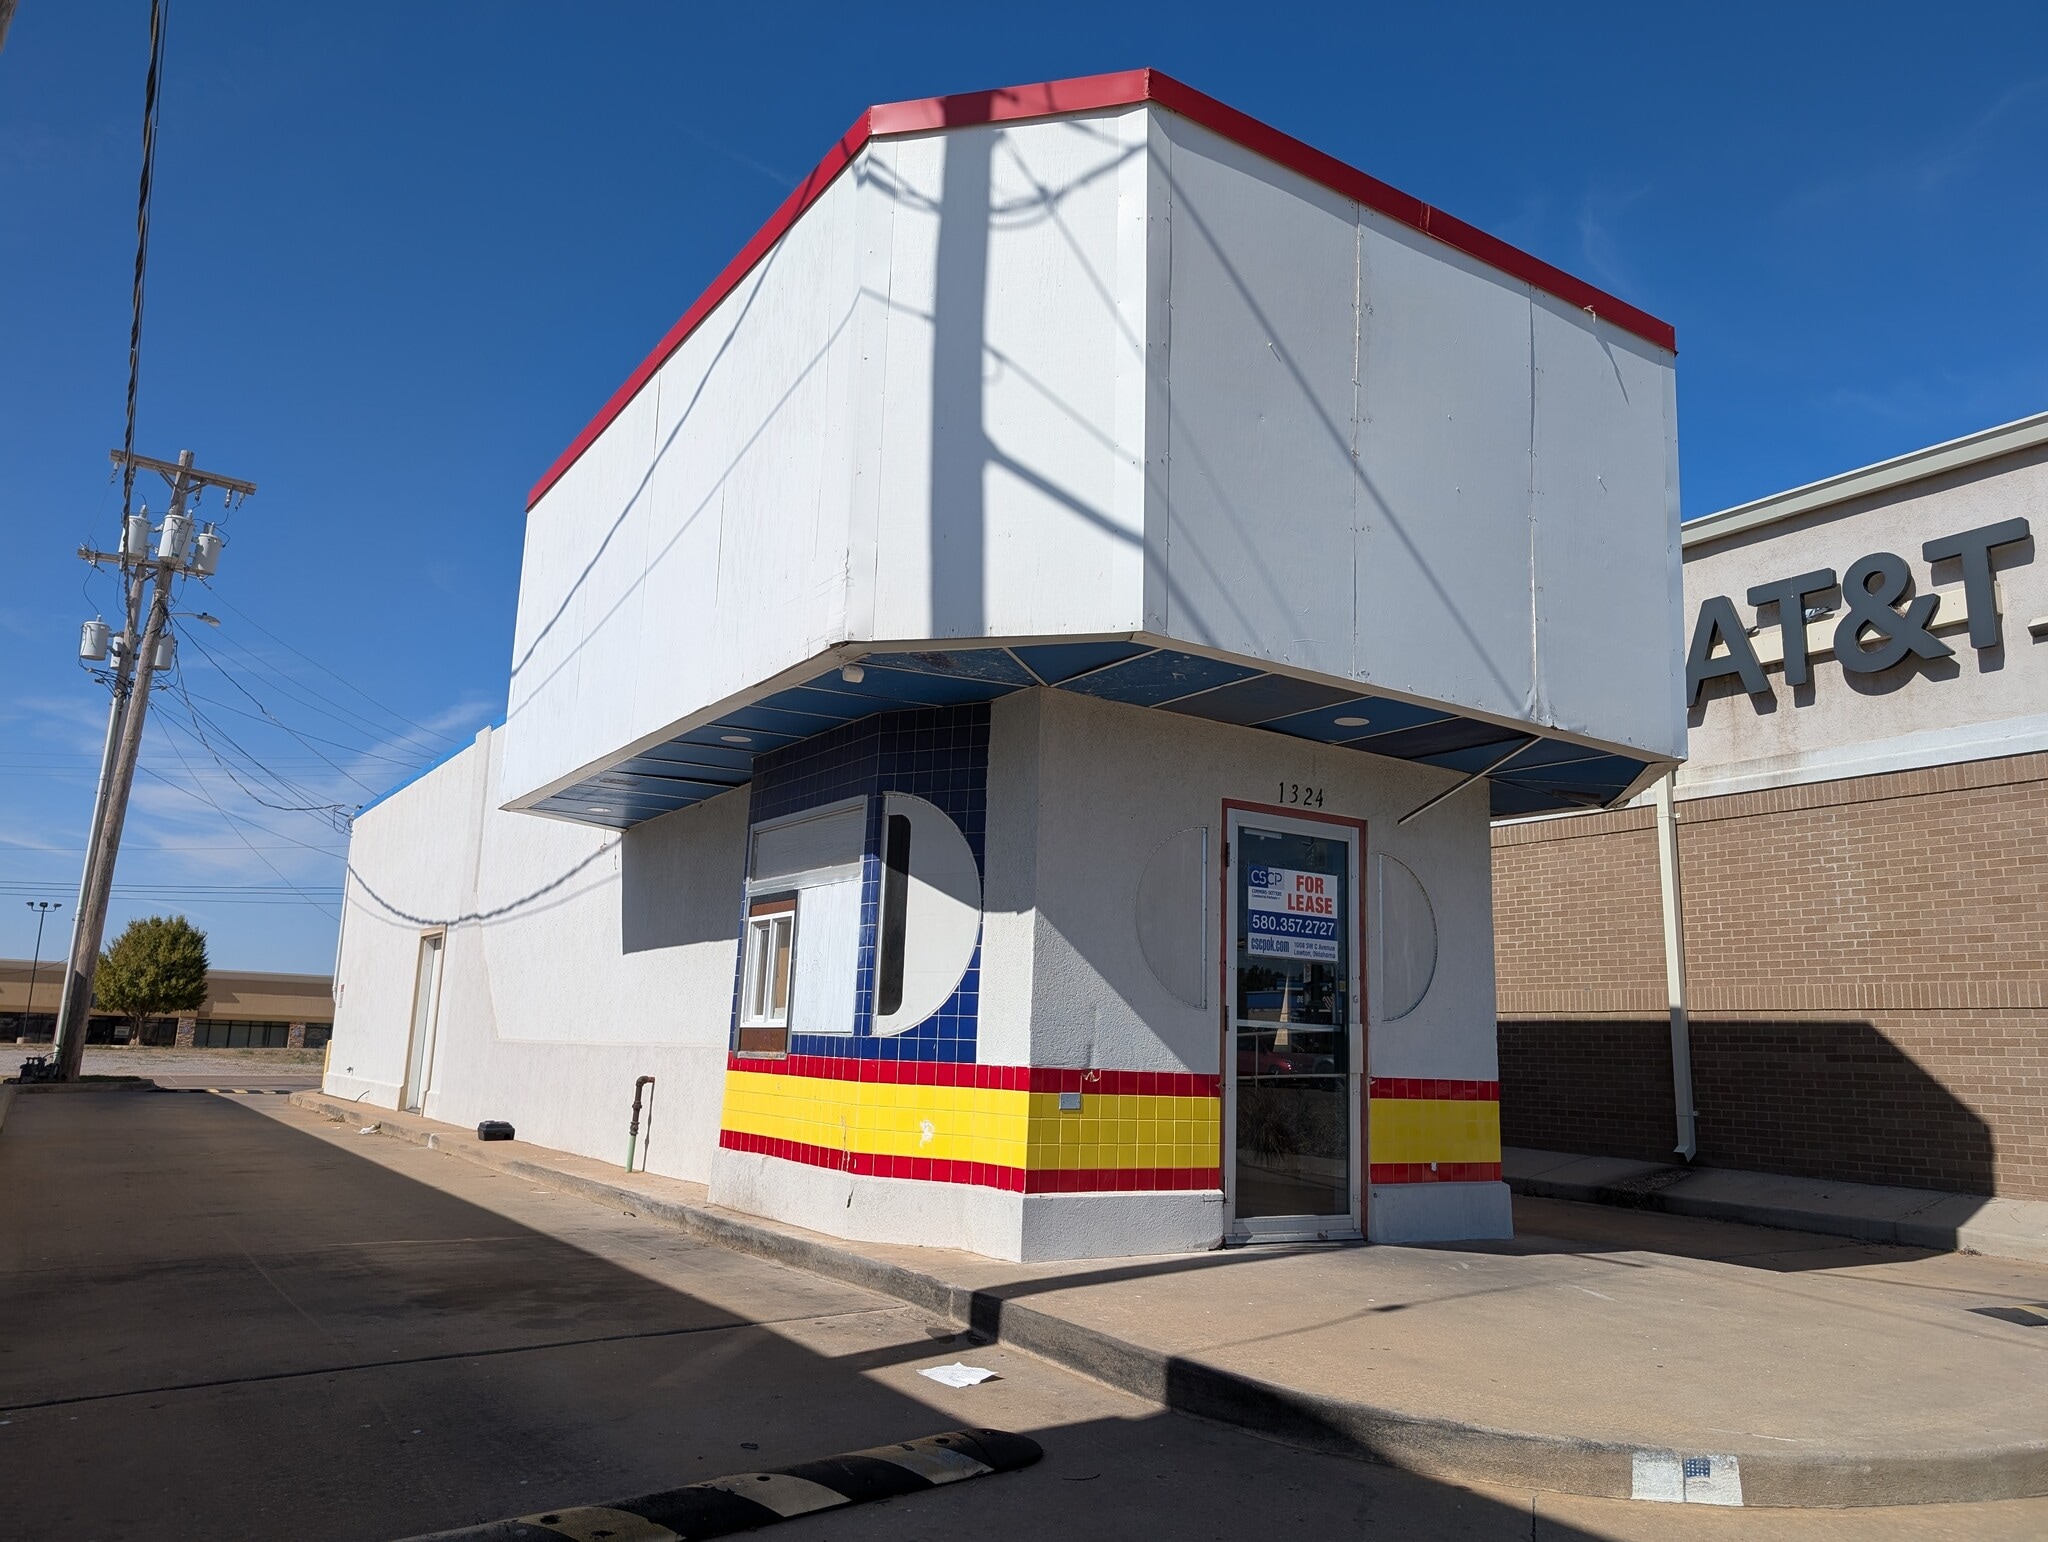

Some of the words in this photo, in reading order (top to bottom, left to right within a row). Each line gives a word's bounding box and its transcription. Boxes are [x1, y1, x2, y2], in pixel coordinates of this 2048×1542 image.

[1686, 517, 2031, 708] AT&T
[1279, 781, 1324, 808] 1324
[1251, 870, 1282, 885] CSCP
[1296, 875, 1324, 894] FOR
[1287, 893, 1333, 915] LEASE
[1252, 915, 1334, 936] 580.357.2727
[1251, 937, 1290, 953] cscpok.com
